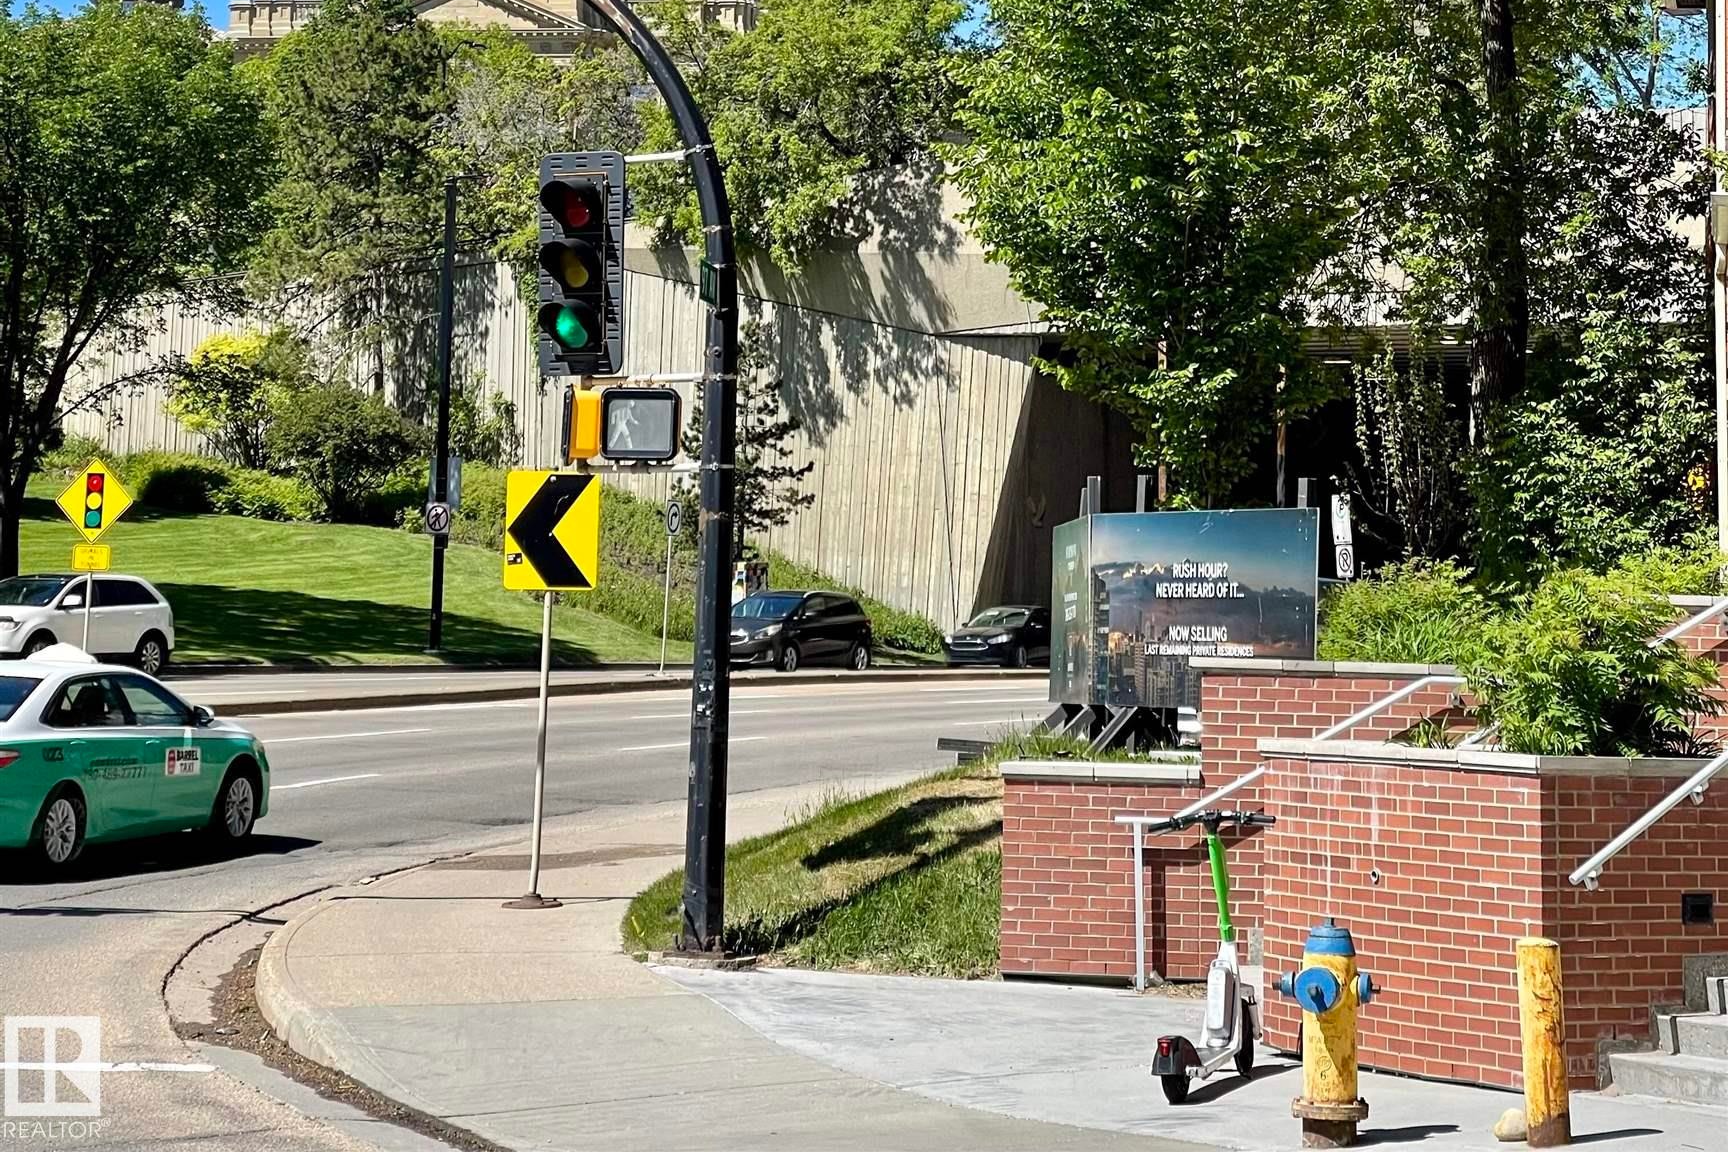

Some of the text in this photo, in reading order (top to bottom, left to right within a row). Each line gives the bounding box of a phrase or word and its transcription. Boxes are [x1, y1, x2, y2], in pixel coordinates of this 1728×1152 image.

[1172, 562, 1228, 578] RUSH HOUR?
[1156, 582, 1184, 598] NEVER
[1186, 582, 1215, 598] HEARD
[1216, 582, 1229, 598] OF
[1169, 625, 1227, 642] NOW SELLING
[1144, 643, 1159, 655] LAST
[1192, 645, 1216, 657] PRIVATE
[176, 750, 199, 761] BARREL
[180, 762, 194, 773] TAXI
